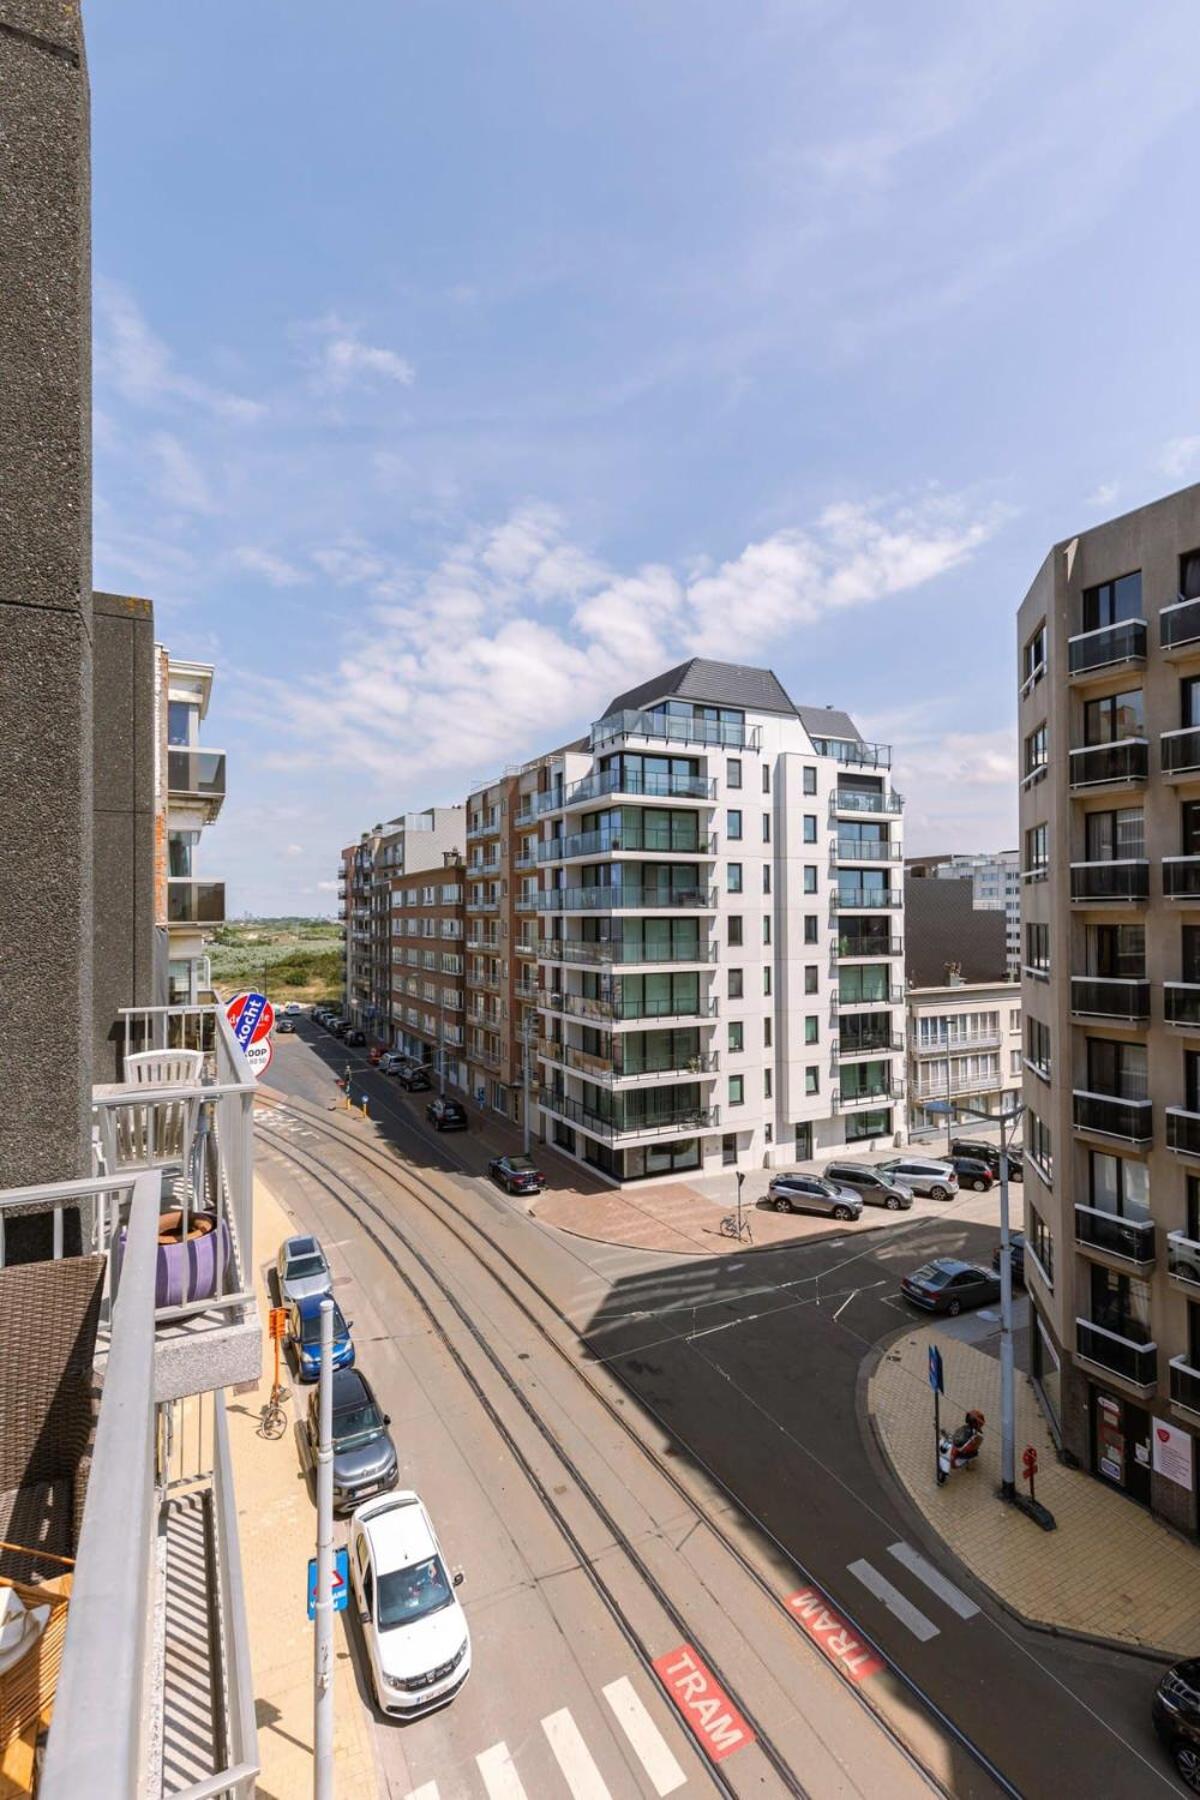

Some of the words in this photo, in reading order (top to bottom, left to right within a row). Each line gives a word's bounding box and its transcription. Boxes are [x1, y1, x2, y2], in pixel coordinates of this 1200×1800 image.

[245, 1048, 267, 1058] OOP
[791, 1591, 870, 1675] TRAM
[666, 1652, 744, 1750] TRAM
